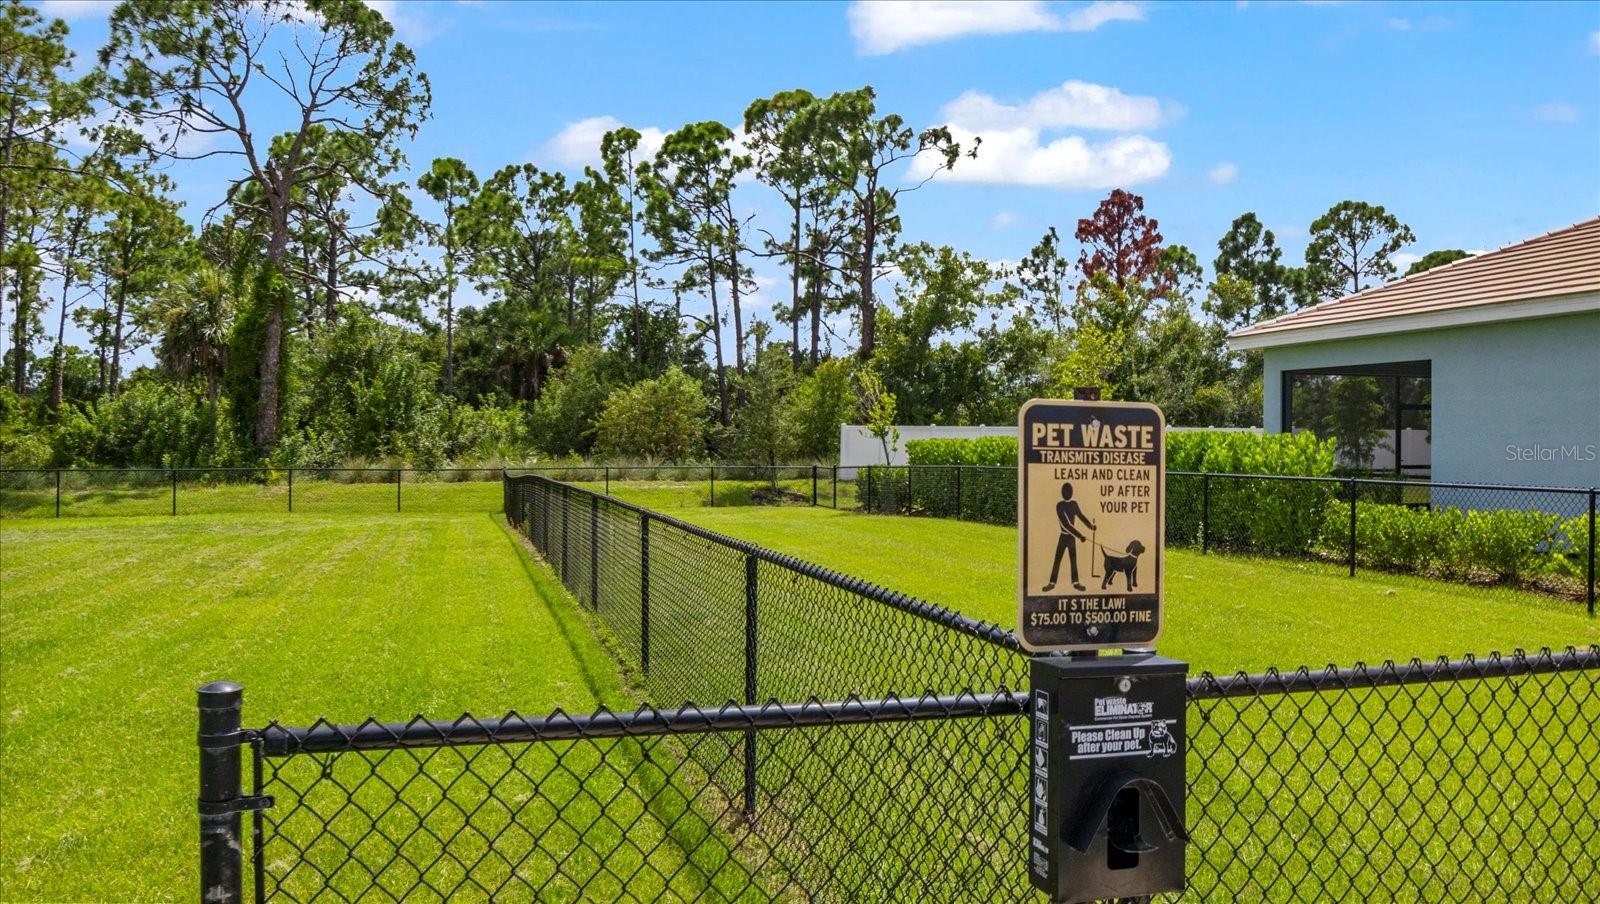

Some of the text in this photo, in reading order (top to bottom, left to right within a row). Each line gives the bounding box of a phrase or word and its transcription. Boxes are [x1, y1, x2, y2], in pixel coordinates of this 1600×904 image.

[1032, 422, 1154, 448] PET WASTE
[1040, 450, 1146, 465] TRANSMITS DISEASE
[1054, 468, 1150, 481] LEASH AND CLEAN
[1100, 485, 1150, 497] UP AFTER
[1100, 501, 1150, 514] YOUR PET
[1058, 598, 1126, 611] IT S THE LAW!
[1031, 610, 1152, 626] $75.00 TO $500.00 FINE
[1072, 727, 1146, 743] Please Clean Up
[1077, 739, 1142, 754] after your pet.
